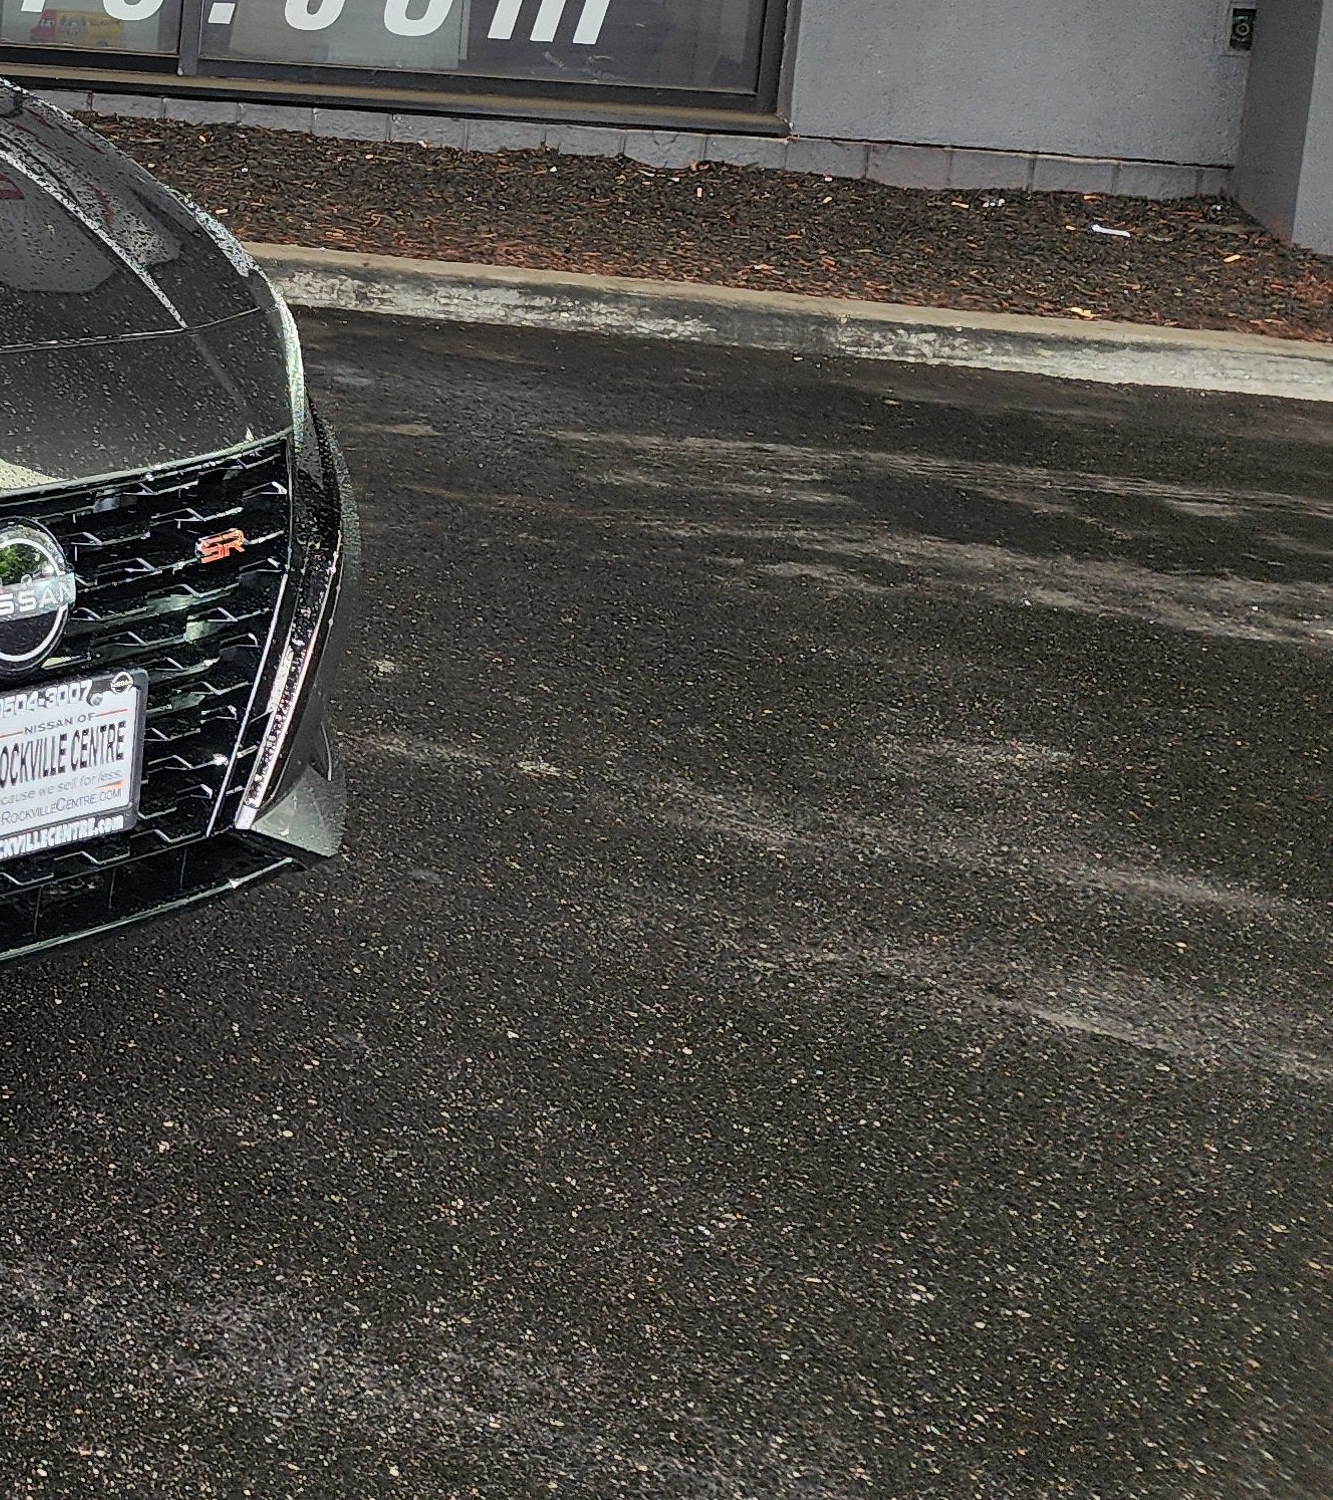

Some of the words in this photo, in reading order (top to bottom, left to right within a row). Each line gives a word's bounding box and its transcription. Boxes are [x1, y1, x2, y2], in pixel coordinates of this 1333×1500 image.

[195, 528, 246, 564] SR
[24, 716, 74, 735] NISSAN
[77, 712, 96, 723] OF
[71, 720, 127, 772] CENTRE
[38, 784, 56, 797] we
[57, 777, 78, 793] sell
[78, 773, 97, 791] for
